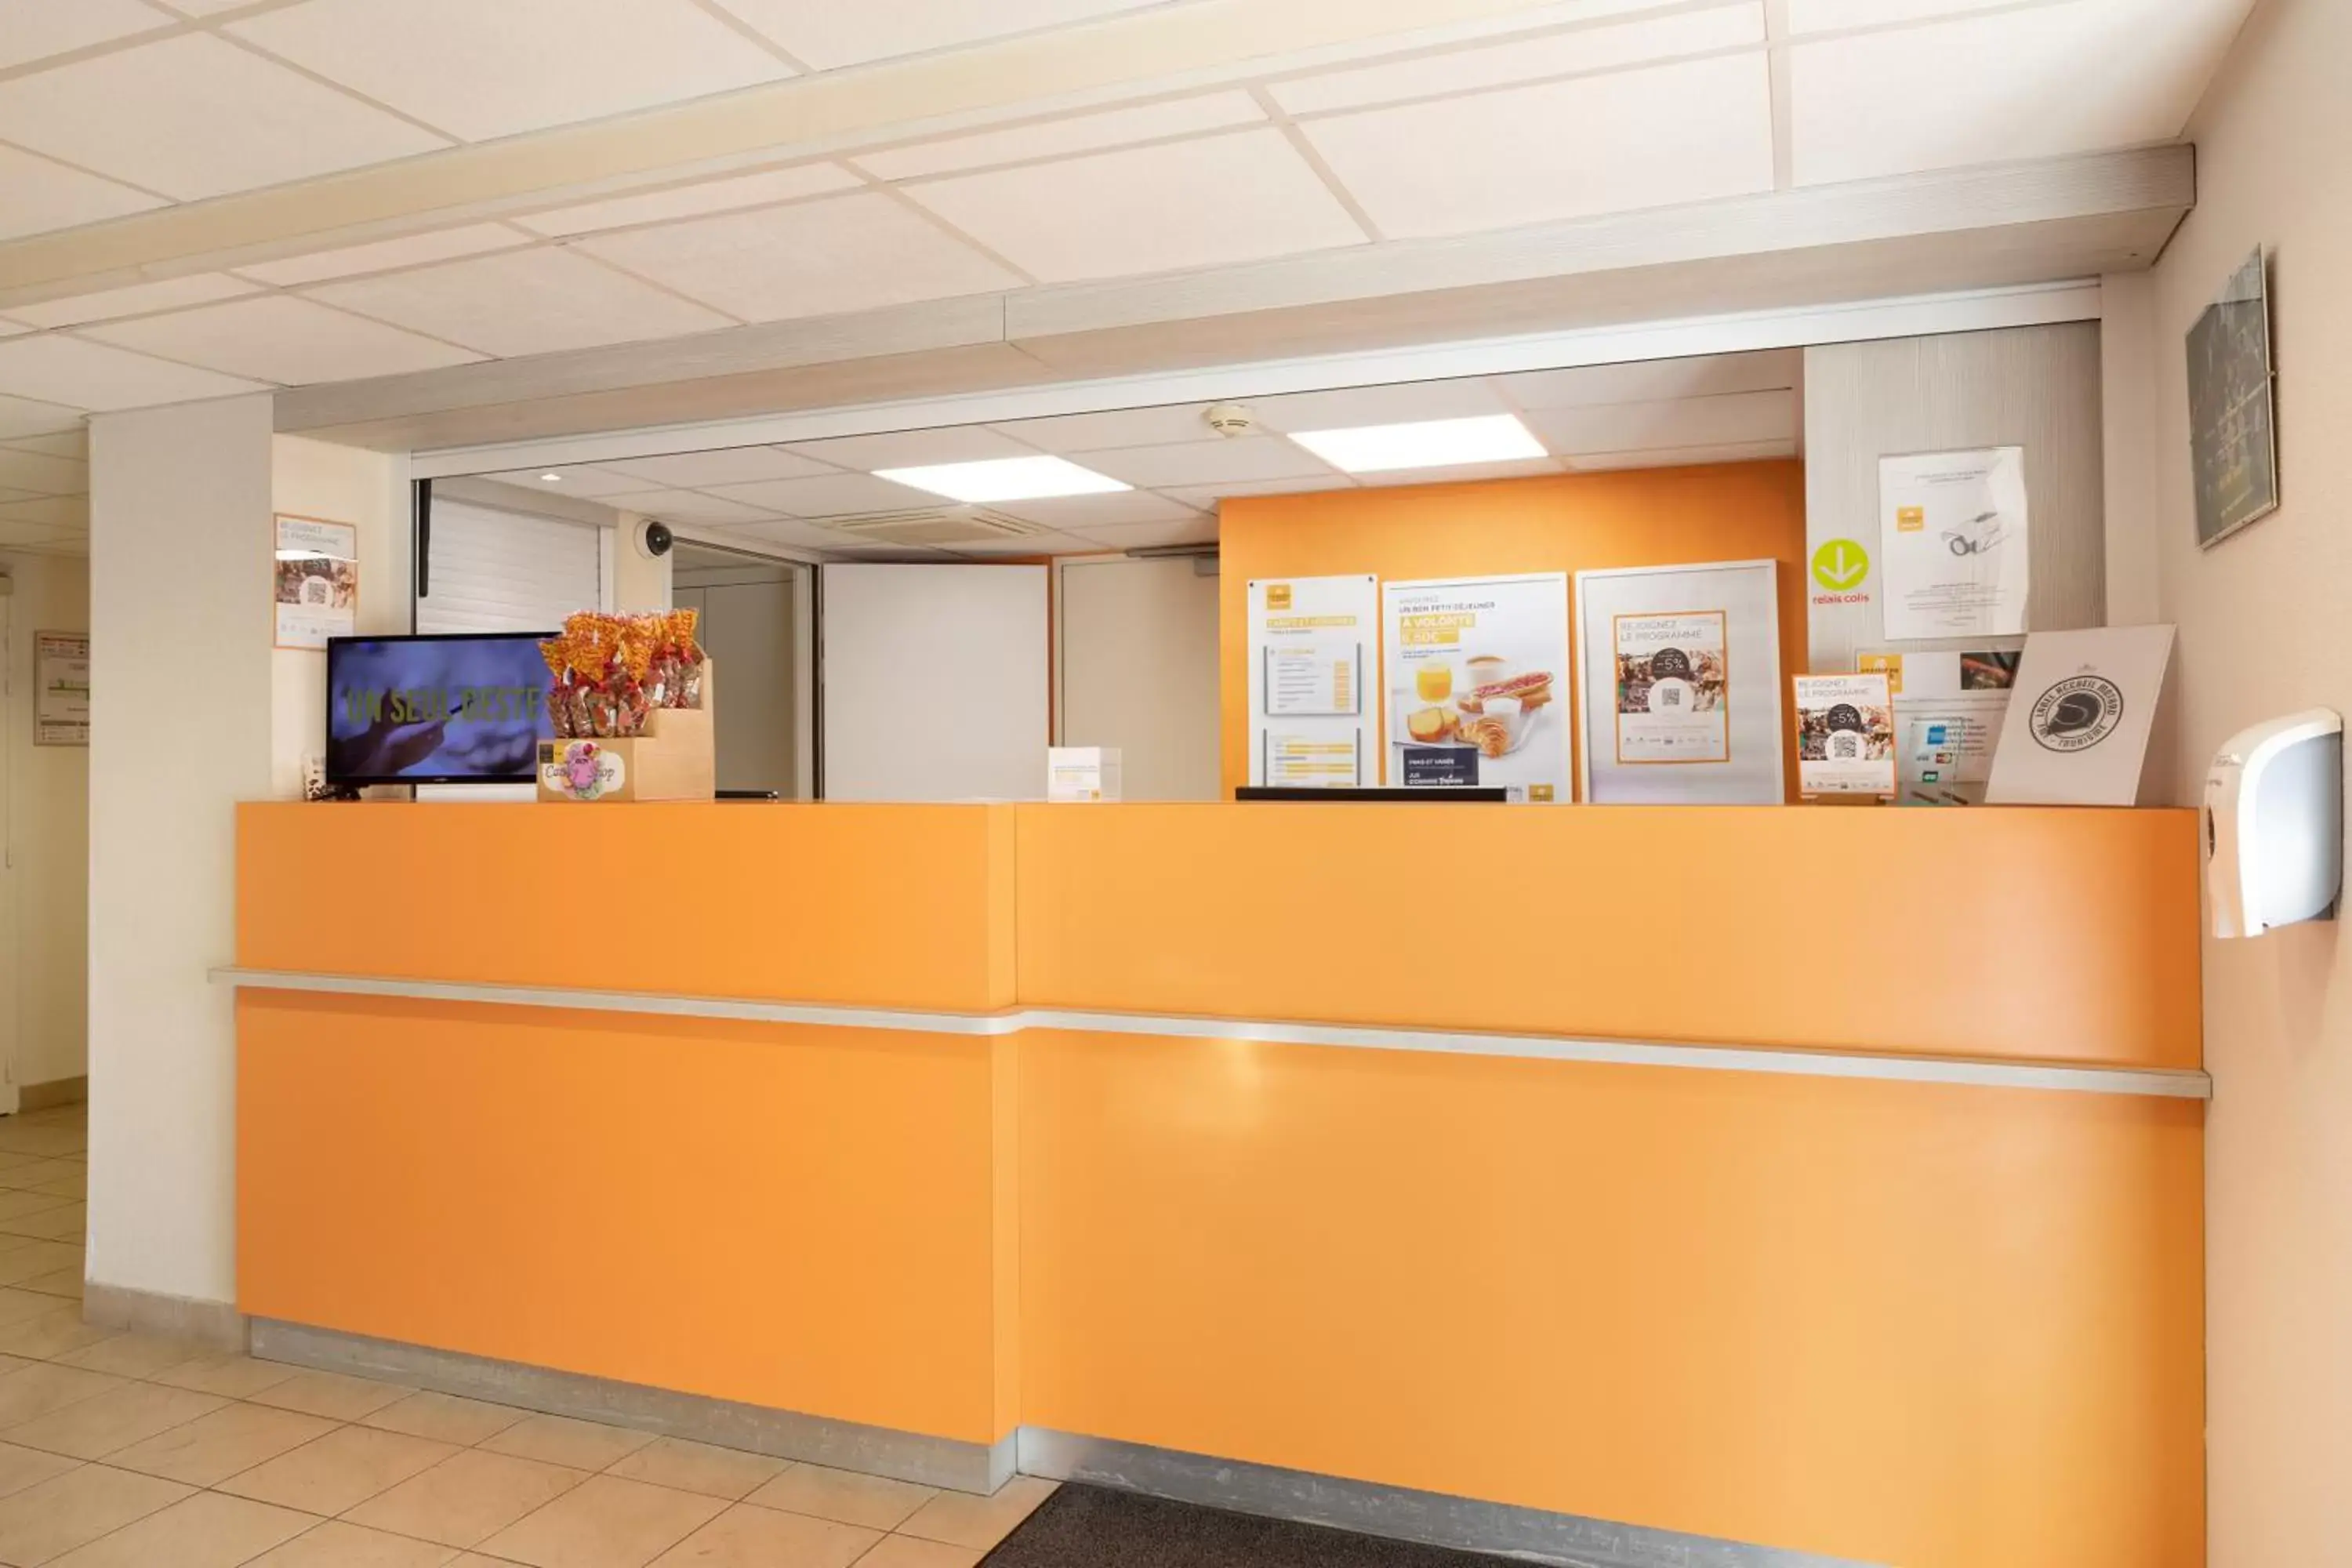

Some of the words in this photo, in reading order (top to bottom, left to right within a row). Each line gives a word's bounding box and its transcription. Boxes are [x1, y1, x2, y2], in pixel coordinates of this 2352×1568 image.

[1813, 593, 1842, 604] relais
[1844, 593, 1869, 603] colis
[1621, 631, 1632, 642] LE
[1635, 628, 1704, 641] PROGRAMME
[1656, 658, 1684, 670] -5%
[347, 687, 383, 723] UN
[390, 687, 452, 723] SEUL
[461, 685, 541, 723] GESTE
[1831, 712, 1857, 724] -5%
